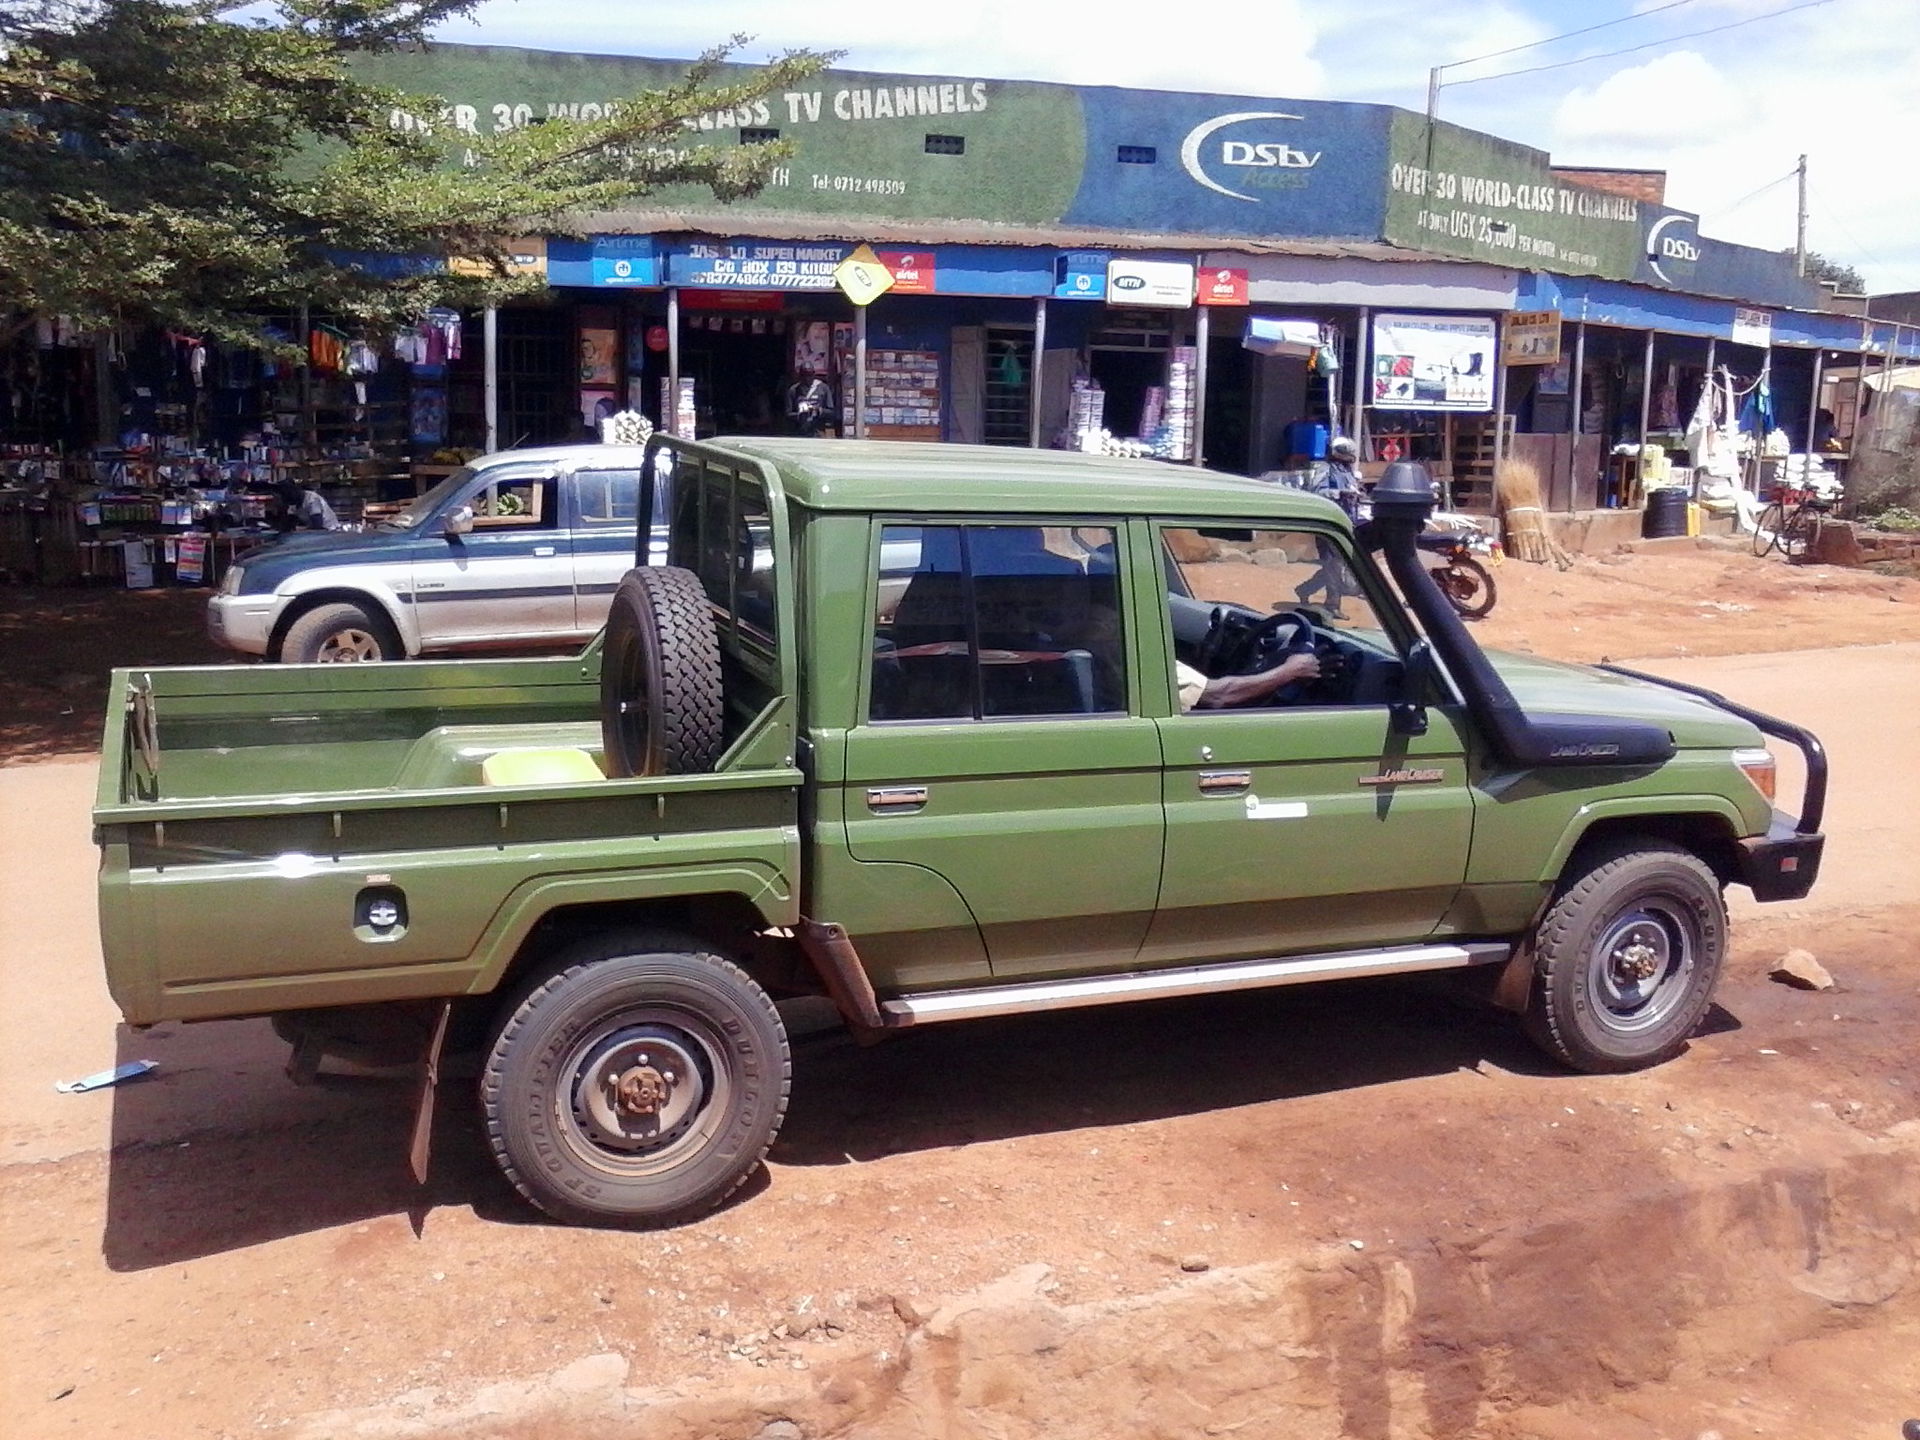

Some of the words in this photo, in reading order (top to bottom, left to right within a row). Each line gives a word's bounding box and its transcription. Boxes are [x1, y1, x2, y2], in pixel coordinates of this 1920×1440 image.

[492, 103, 533, 132] 30
[784, 92, 822, 123] TV
[834, 82, 988, 120] CHANNELS
[1223, 141, 1322, 167] DStv
[1437, 172, 1457, 199] 30
[1461, 176, 1554, 213] WORLD-CLASS
[1560, 189, 1576, 214] TV
[1578, 192, 1637, 222] CHANNELS
[1450, 210, 1476, 239] UGX
[754, 247, 794, 260] SUPER
[796, 248, 842, 260] MARKET
